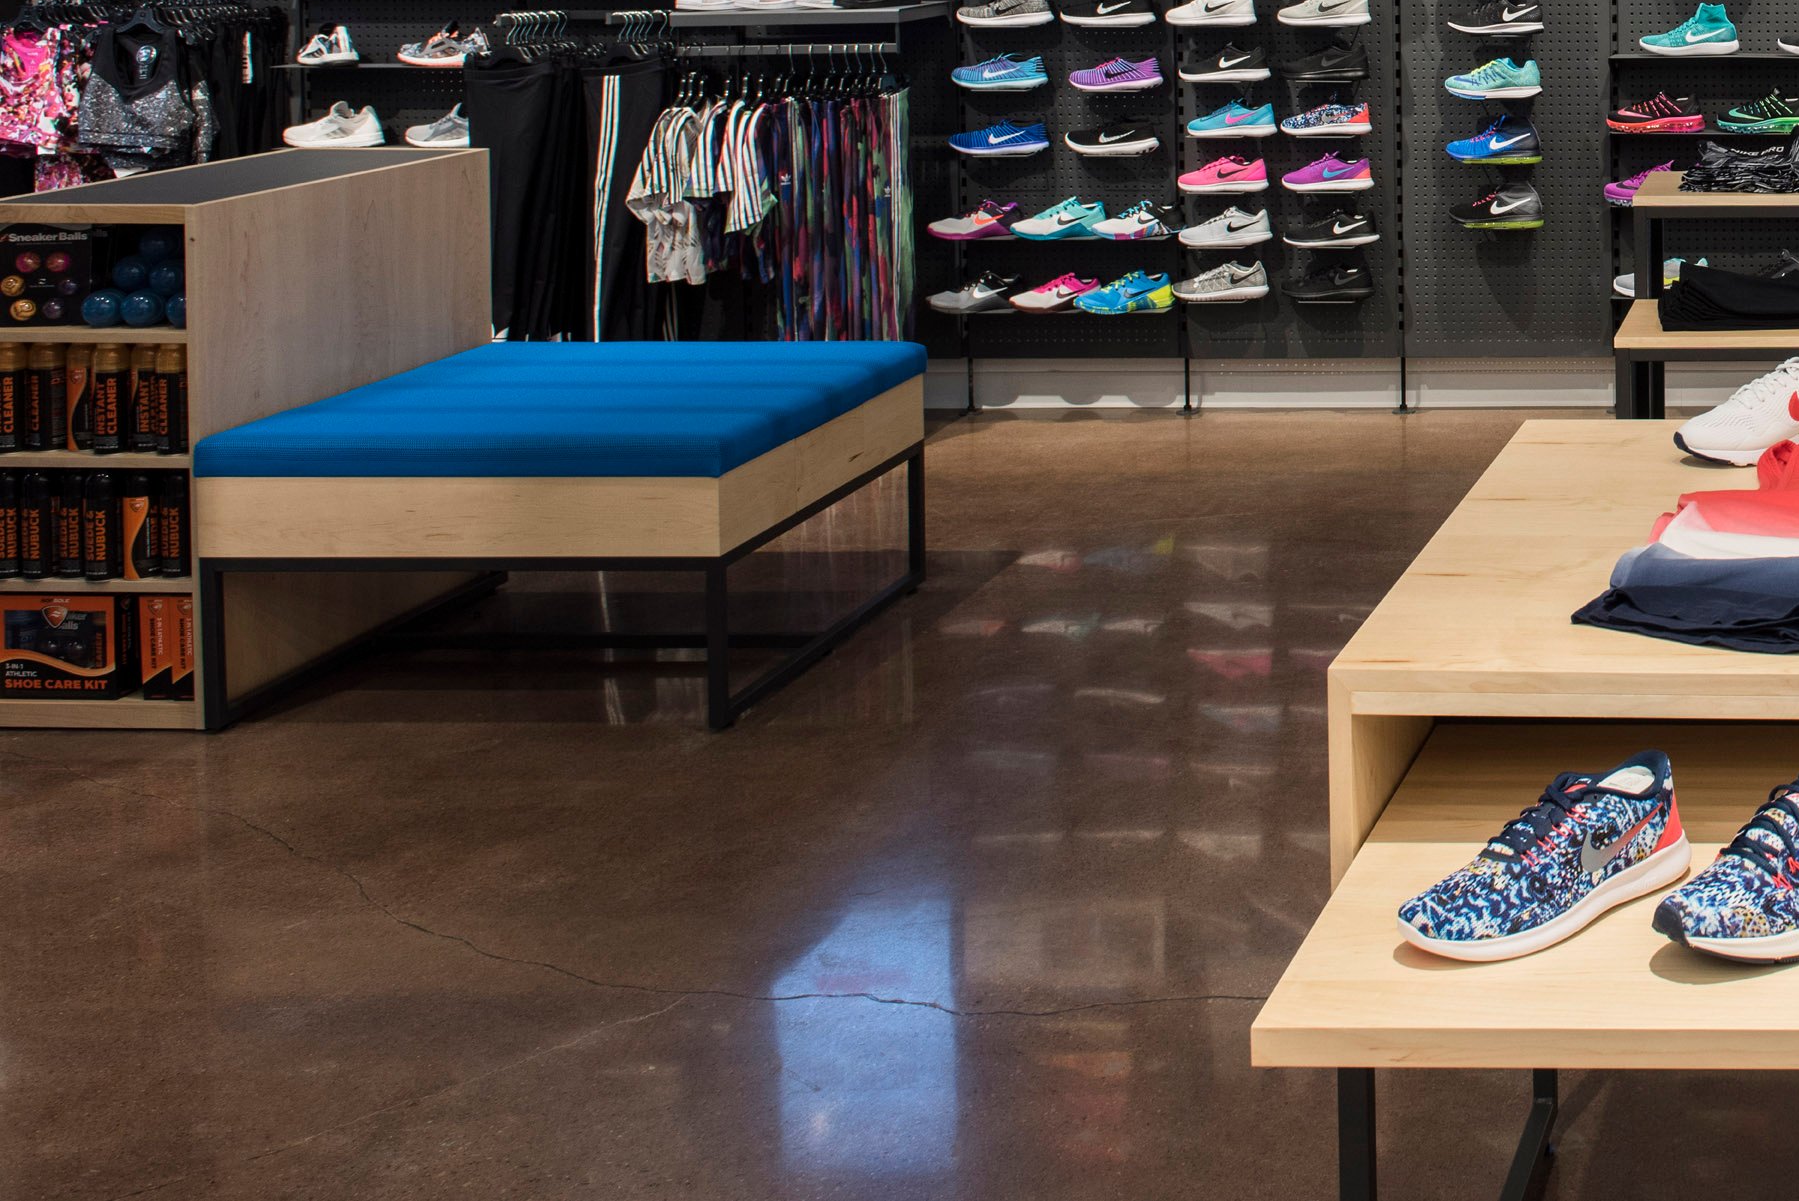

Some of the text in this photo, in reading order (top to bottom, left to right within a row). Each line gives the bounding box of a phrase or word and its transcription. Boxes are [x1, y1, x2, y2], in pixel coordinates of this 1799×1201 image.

[1760, 146, 1785, 156] PRO
[8, 233, 58, 243] Sneaker
[58, 231, 88, 242] Balls
[2, 376, 15, 433] CLEANER
[30, 375, 40, 432] CLEANER
[96, 382, 106, 435] INSTANT
[106, 377, 118, 435] CLEANER
[138, 379, 150, 433] INSTANT
[159, 378, 169, 435] CLEANER
[6, 507, 18, 560] NUBUCK
[29, 508, 40, 560] NUBUCK
[68, 507, 80, 559] NUBUCK
[85, 521, 95, 561] SUEDE
[95, 510, 107, 561] NUBUCK
[169, 506, 180, 558] NUBUCK
[4, 670, 38, 678] ATHLETIC
[4, 679, 108, 690] SHOE CARE KIT
